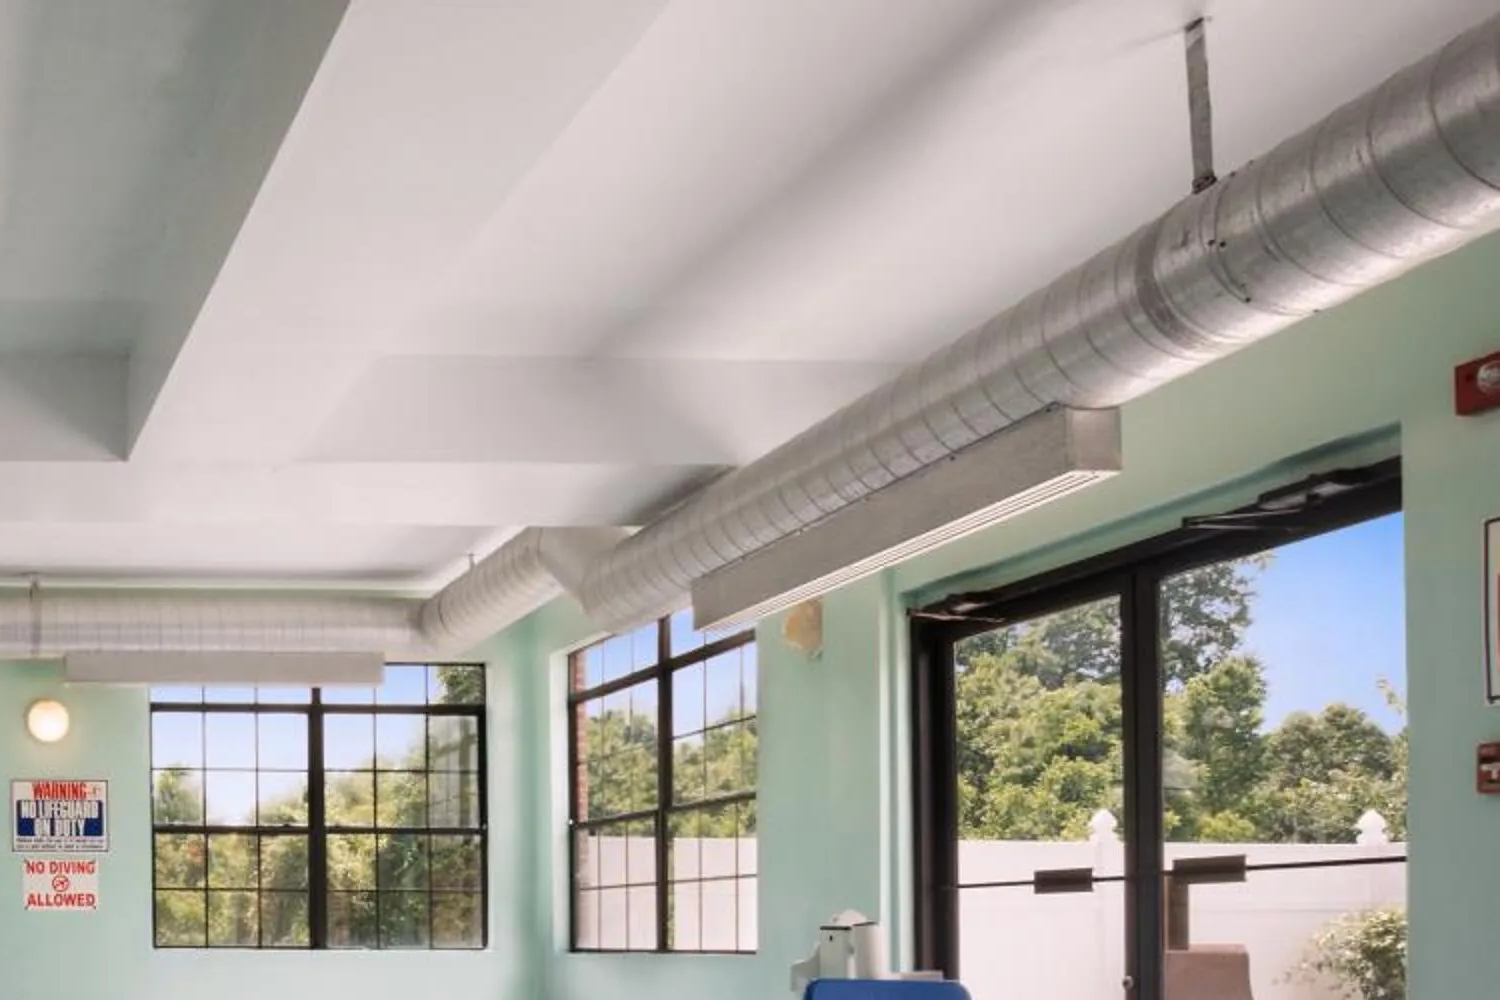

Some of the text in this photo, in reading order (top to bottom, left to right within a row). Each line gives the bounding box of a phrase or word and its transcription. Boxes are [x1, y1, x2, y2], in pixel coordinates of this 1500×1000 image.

[32, 783, 87, 799] WARNING
[21, 801, 98, 818] NO LIFEGUARD
[35, 819, 84, 836] ON DUTY
[26, 862, 95, 874] NO DIVING
[27, 894, 95, 906] ALLOWED
